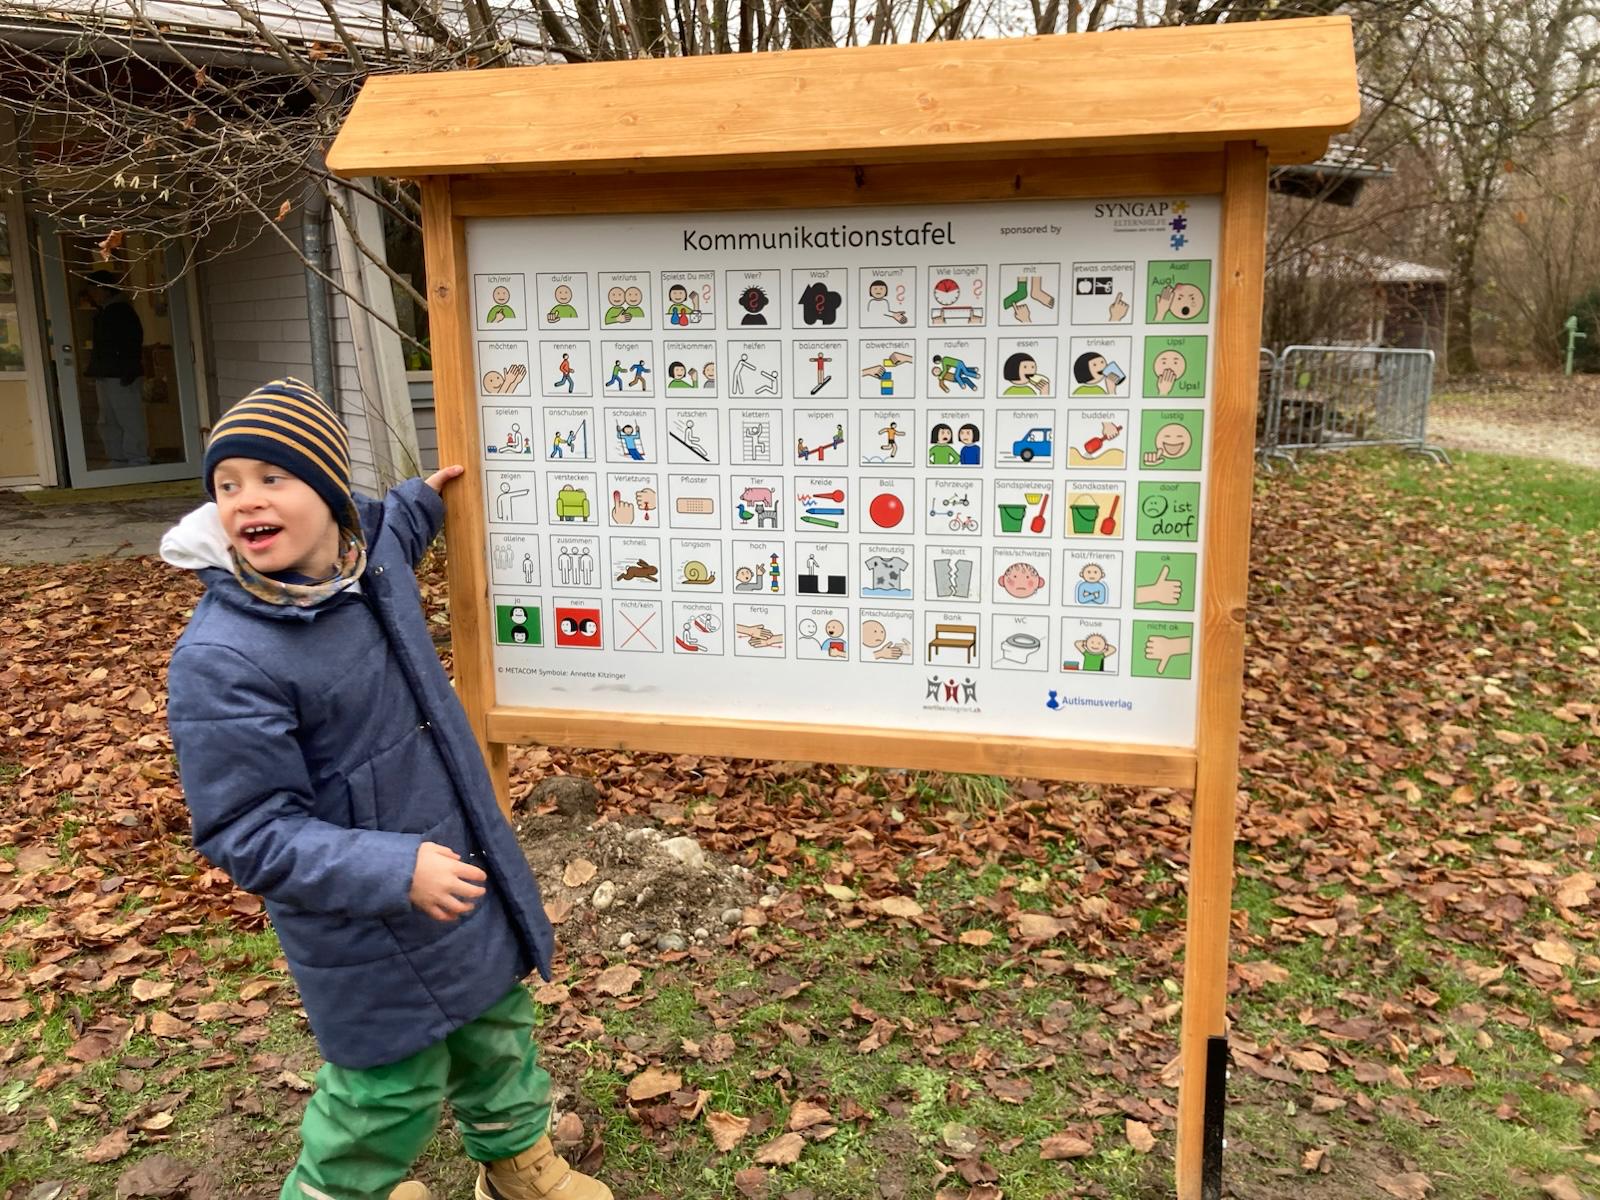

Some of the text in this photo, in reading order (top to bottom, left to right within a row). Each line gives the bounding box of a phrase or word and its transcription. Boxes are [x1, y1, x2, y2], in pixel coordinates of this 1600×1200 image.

[1095, 201, 1168, 218] SYNGAP
[1001, 225, 1062, 235] sponsored by
[683, 221, 956, 251] Kommunikationstafel
[1023, 265, 1037, 274] mit
[1074, 263, 1134, 273] etwas anderes
[1169, 262, 1190, 271] Aua!
[744, 271, 762, 280] Wer?
[810, 270, 829, 279] Was?
[872, 269, 904, 277] Warum?
[937, 266, 979, 277] Wie lange?
[612, 274, 637, 282] wir/uns
[662, 272, 713, 281] Spielst Du mit?
[1152, 274, 1175, 286] Aua!
[488, 342, 518, 351] möchten
[614, 342, 639, 351] fangen
[666, 342, 713, 351] (mit)kommen
[743, 342, 766, 350] helfen
[799, 342, 842, 350] balancieren
[866, 341, 910, 350] abwechseln
[944, 340, 969, 349] raufen
[1086, 338, 1115, 347] trinken
[1167, 338, 1186, 347] Ups!
[1179, 380, 1200, 392] Ups!
[495, 408, 519, 417] spielen
[548, 408, 588, 417] anschubsen
[612, 409, 647, 418] schaukeln
[677, 410, 708, 418] rutschen
[742, 411, 770, 419] klettern
[807, 411, 834, 420] wippen
[874, 411, 900, 420] hüpfen
[941, 411, 970, 419] streiten
[1013, 411, 1039, 420] fahren
[1082, 411, 1115, 420] buddeln
[1161, 411, 1184, 421] lustig
[500, 472, 522, 481] zeigen
[554, 473, 589, 481] verstecken
[614, 475, 651, 484] Verletzung
[681, 476, 708, 484] Pflaster
[750, 477, 764, 485] Tier
[810, 478, 832, 486] Kreide
[879, 480, 894, 488] Ball
[935, 480, 974, 490] Fahrzeuge
[996, 480, 1052, 491] Sandspielzeug
[1072, 482, 1119, 491] Sandkasten
[1160, 483, 1179, 492] doof
[1173, 501, 1193, 513] ist
[1153, 515, 1195, 536] doof
[681, 541, 711, 549] langsam
[749, 542, 767, 550] hoch
[815, 543, 828, 551] tief
[868, 545, 905, 555] schmutzig
[941, 548, 966, 557] kaputt
[994, 549, 1050, 559] heiss/schwitzen
[1071, 551, 1116, 561] kalt/frieren
[1161, 554, 1171, 562] ok
[682, 603, 712, 611] nochmal
[750, 606, 768, 615] fertig
[812, 608, 833, 616] danke
[861, 610, 913, 621] Entschuldigung
[943, 613, 962, 622] Bank
[1014, 616, 1026, 625] WC
[1079, 619, 1103, 628] Pause
[1147, 622, 1179, 632] nicht ok
[598, 672, 626, 680] Kitzinger
[1062, 696, 1132, 710] Autismusverlag
